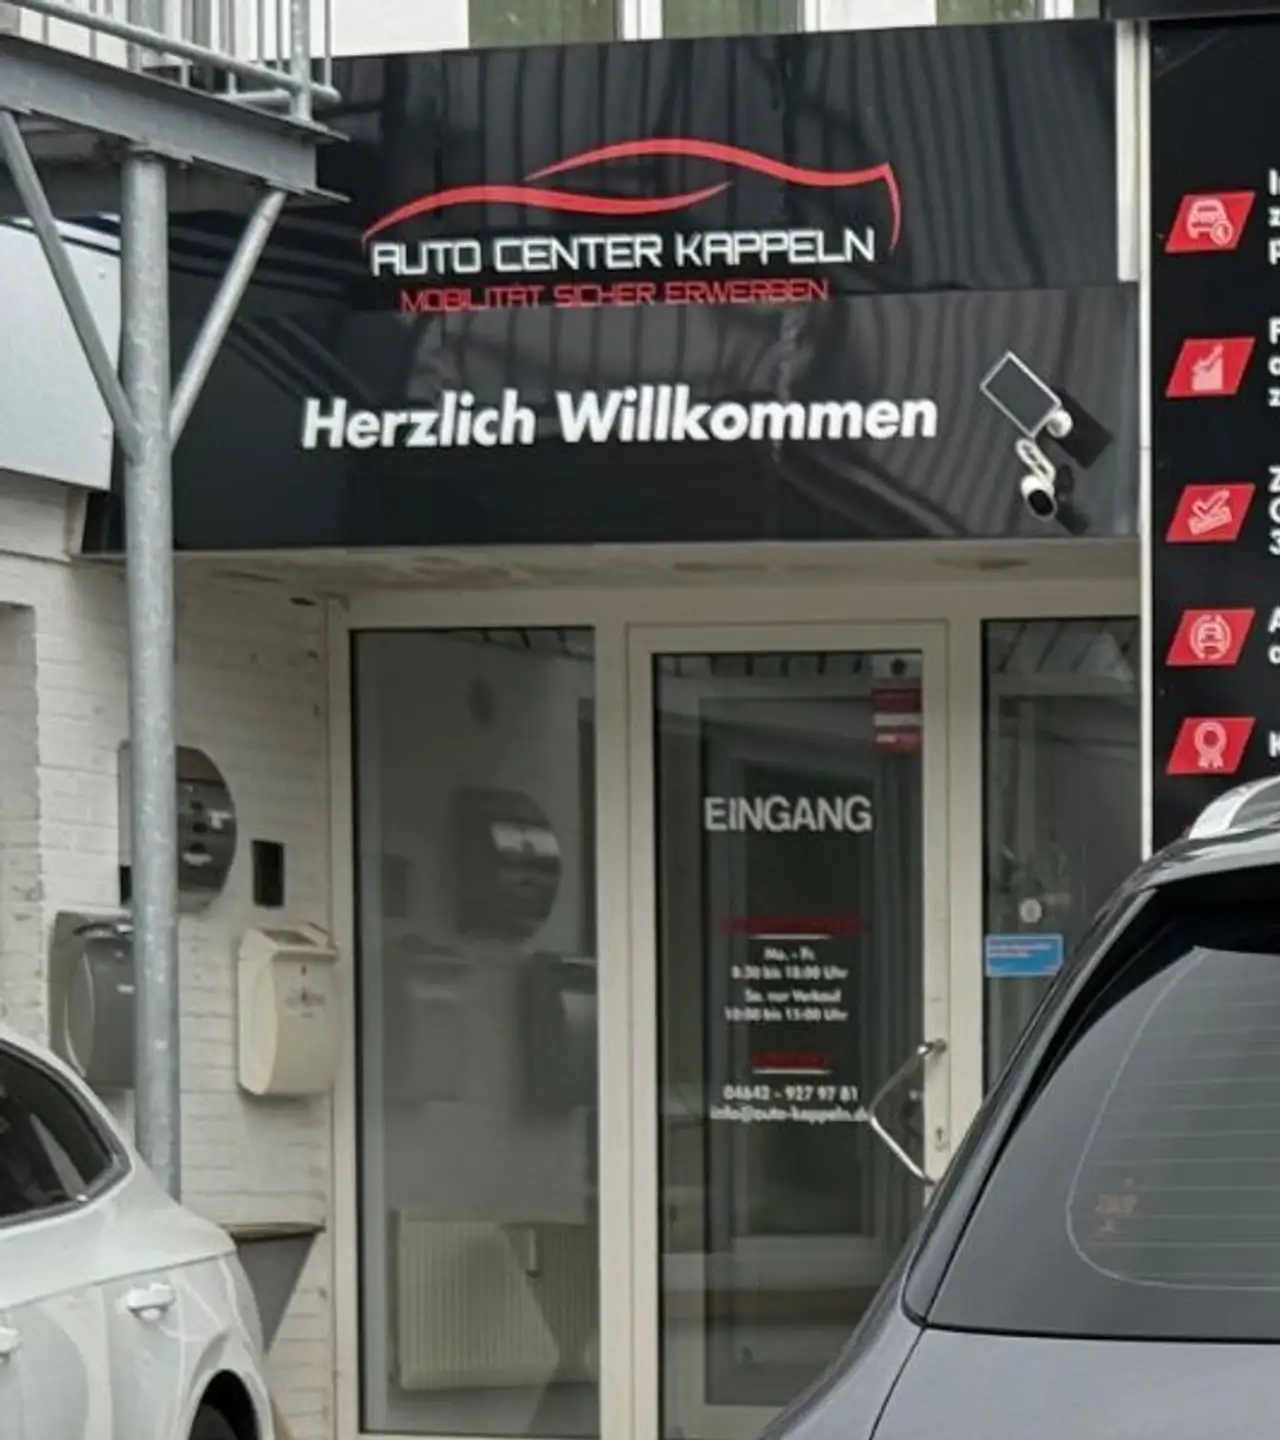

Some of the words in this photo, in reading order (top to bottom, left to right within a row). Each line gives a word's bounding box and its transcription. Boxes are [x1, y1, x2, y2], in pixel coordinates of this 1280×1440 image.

[371, 239, 482, 277] AUTO
[493, 233, 662, 273] CENTER
[675, 226, 876, 267] KAPPELN
[554, 281, 656, 308] SICHER
[664, 278, 829, 306] ERWERBEN
[302, 387, 536, 450] Herzlich
[555, 383, 938, 443] Willkommen
[704, 796, 873, 832] EINGANG
